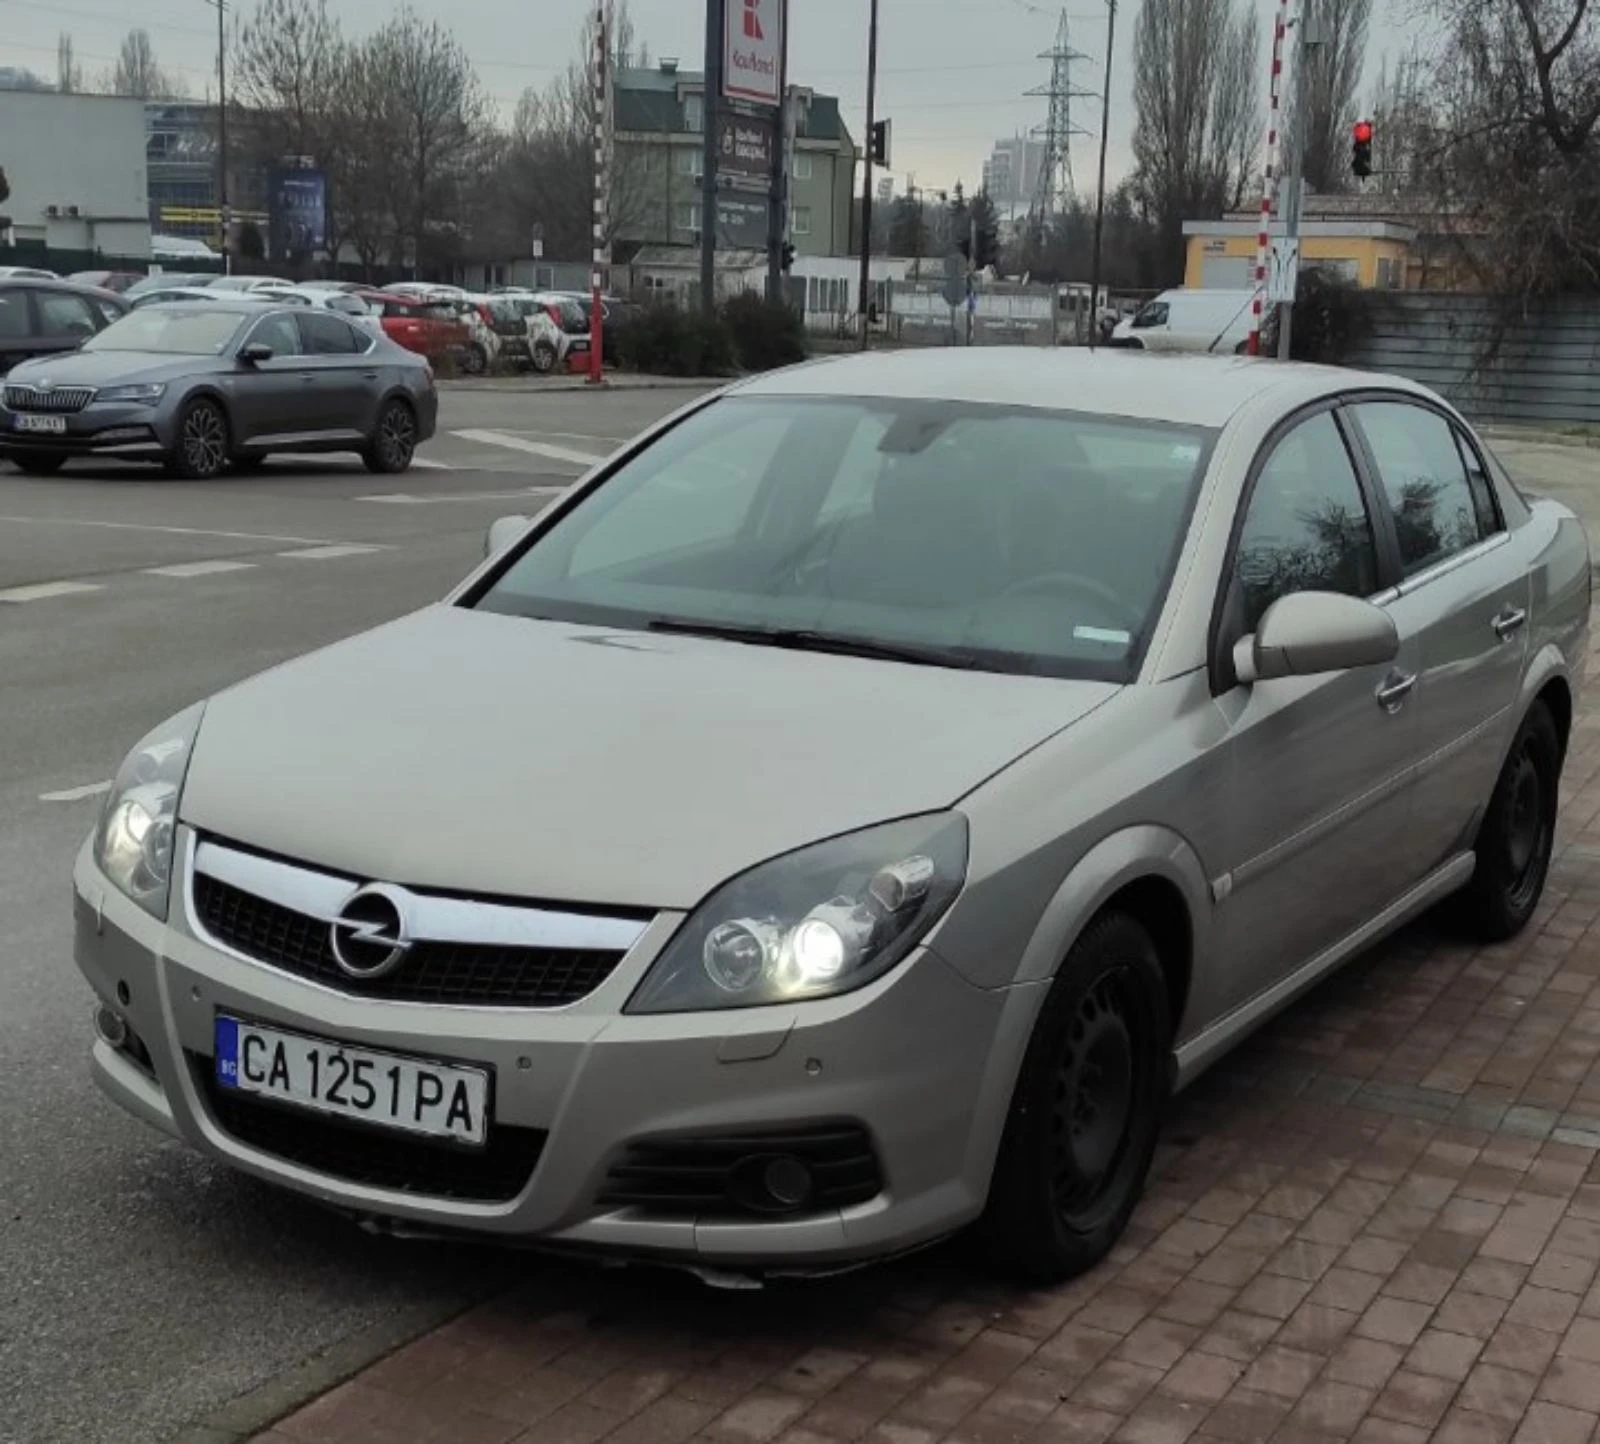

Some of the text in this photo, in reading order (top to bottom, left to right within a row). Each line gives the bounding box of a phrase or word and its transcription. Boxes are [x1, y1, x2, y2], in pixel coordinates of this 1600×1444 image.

[221, 1059, 236, 1076] BG
[243, 1034, 472, 1132] CA 1251 PA
